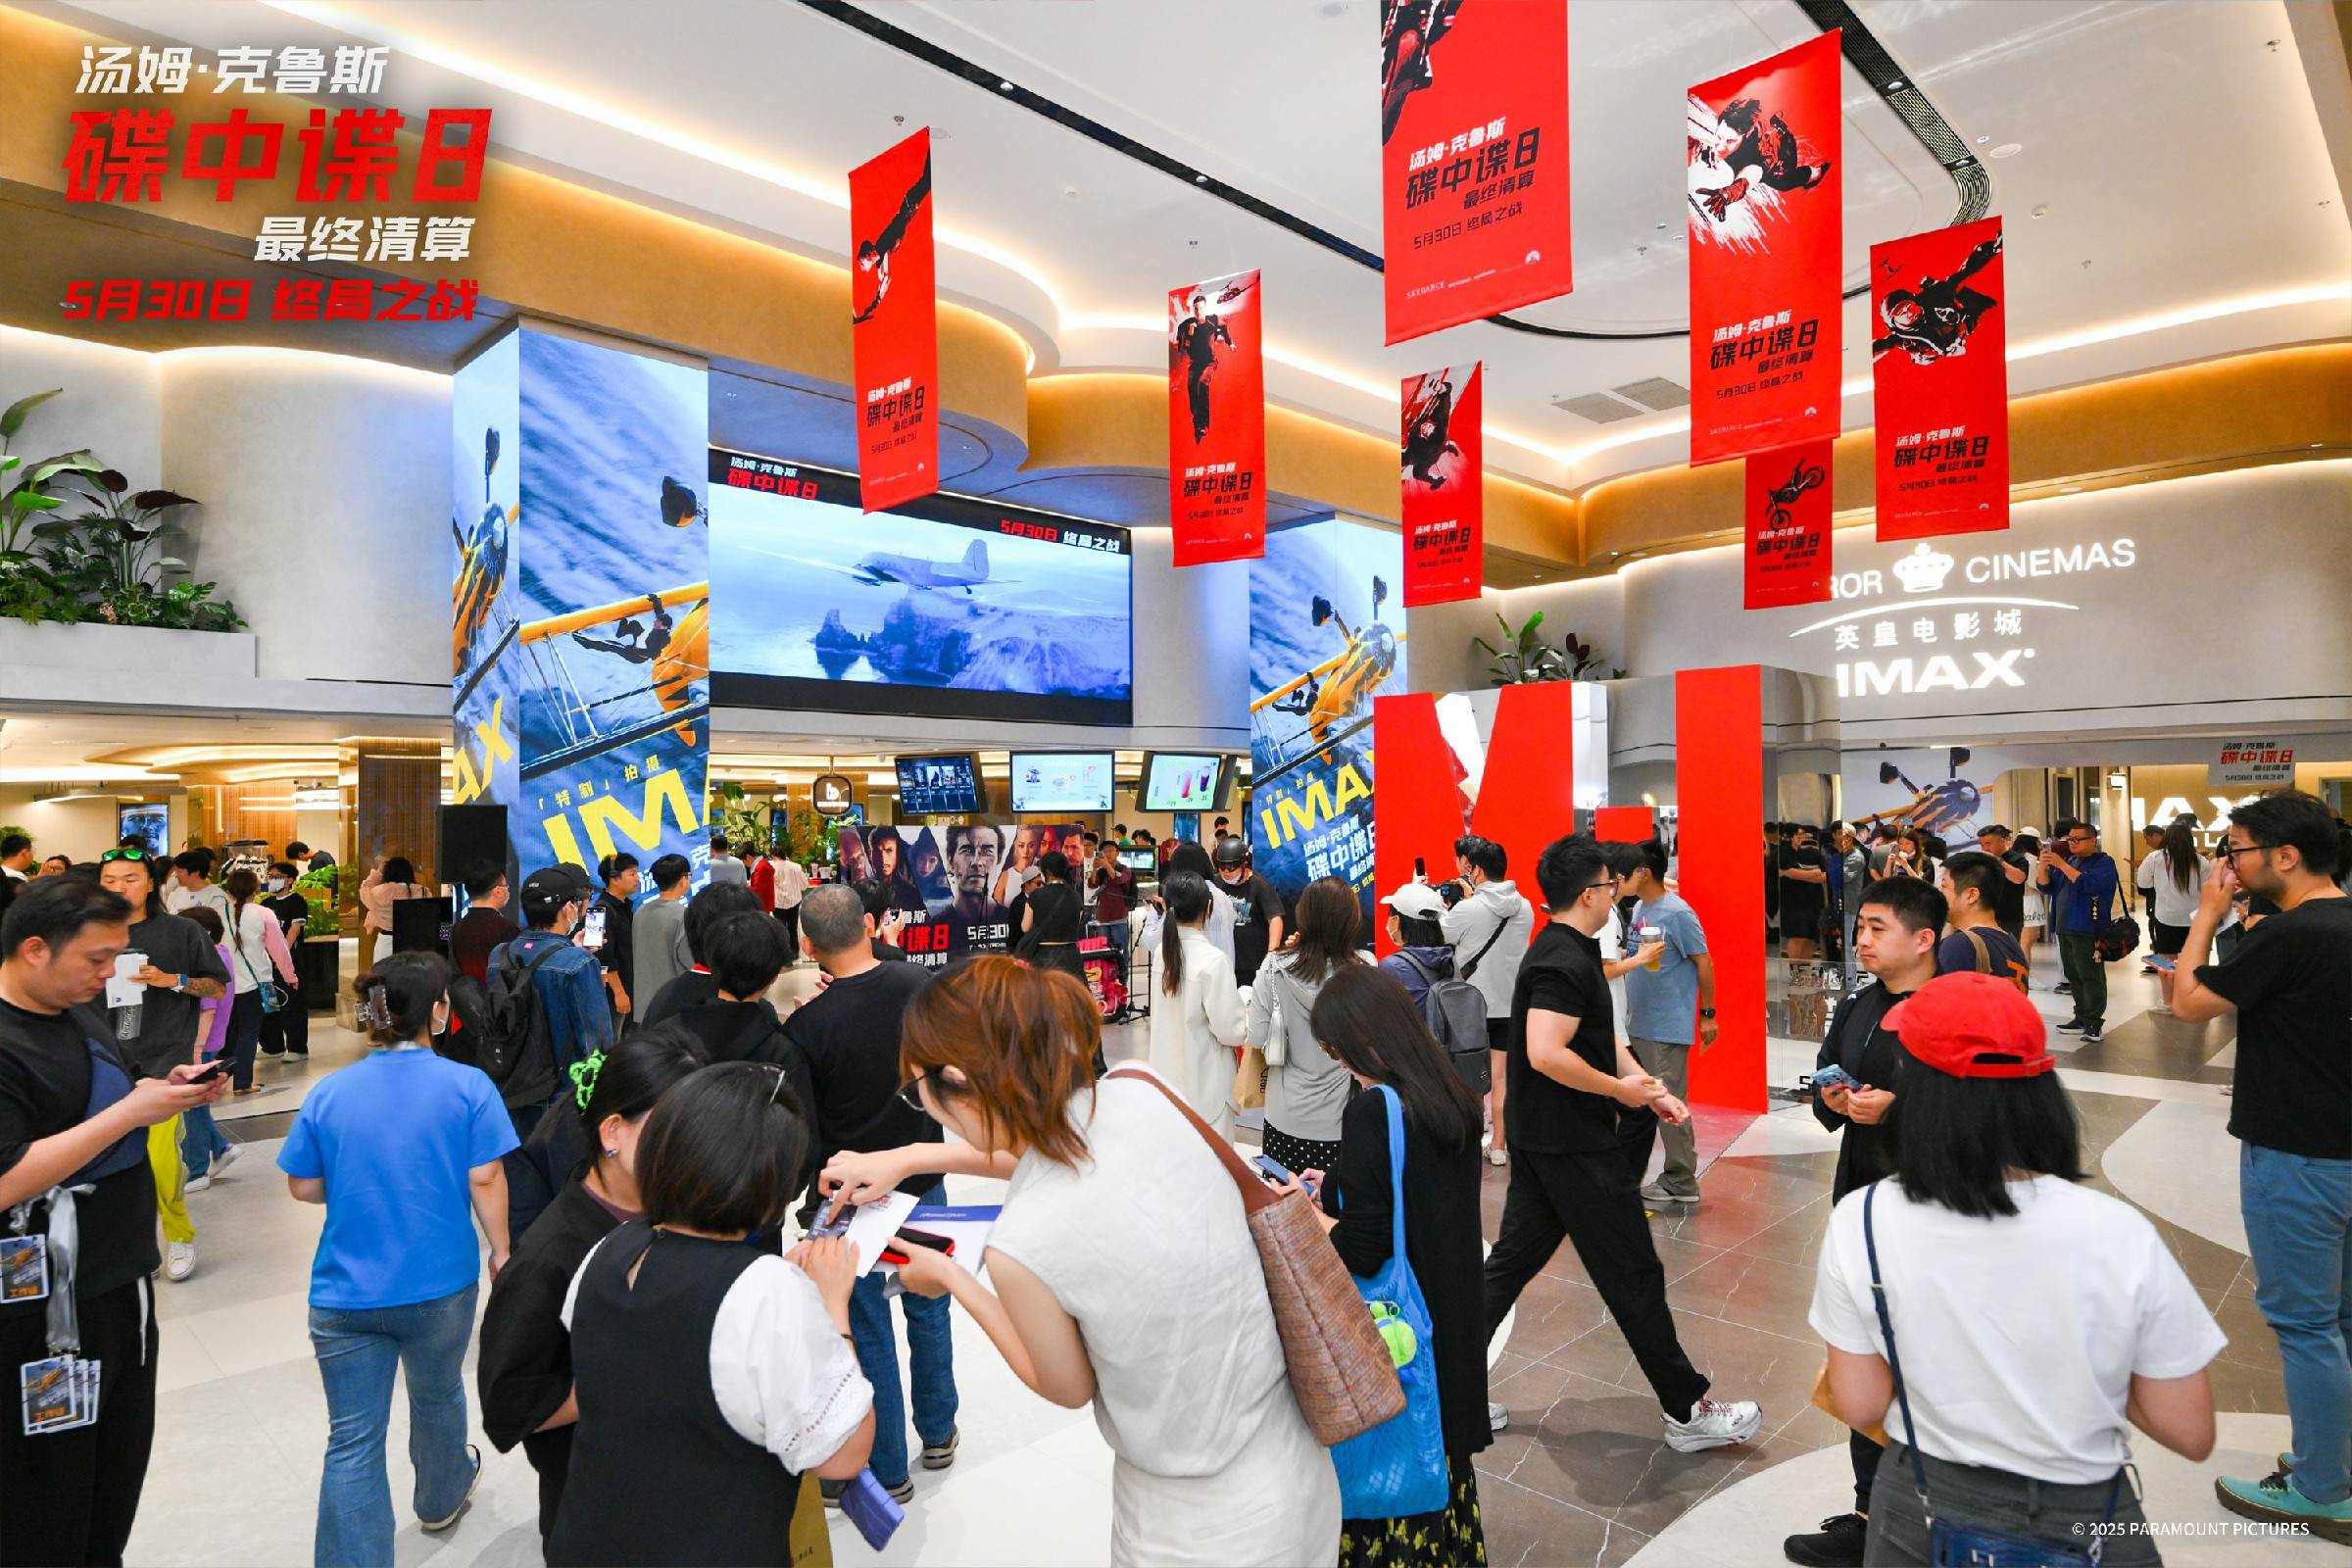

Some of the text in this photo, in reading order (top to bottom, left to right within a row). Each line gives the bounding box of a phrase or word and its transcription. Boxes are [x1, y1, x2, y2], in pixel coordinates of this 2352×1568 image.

[1409, 116, 1506, 172] 汤姆·克鲁斯
[1463, 170, 1535, 210] 最终清算
[1413, 201, 1523, 250] 5月30日 终局之战
[1001, 520, 1120, 553] 5月30日 终局之战
[1966, 539, 2136, 583] CINEMAS
[1835, 609, 2023, 651] 英皇电影城
[1836, 648, 2026, 697] IMAX
